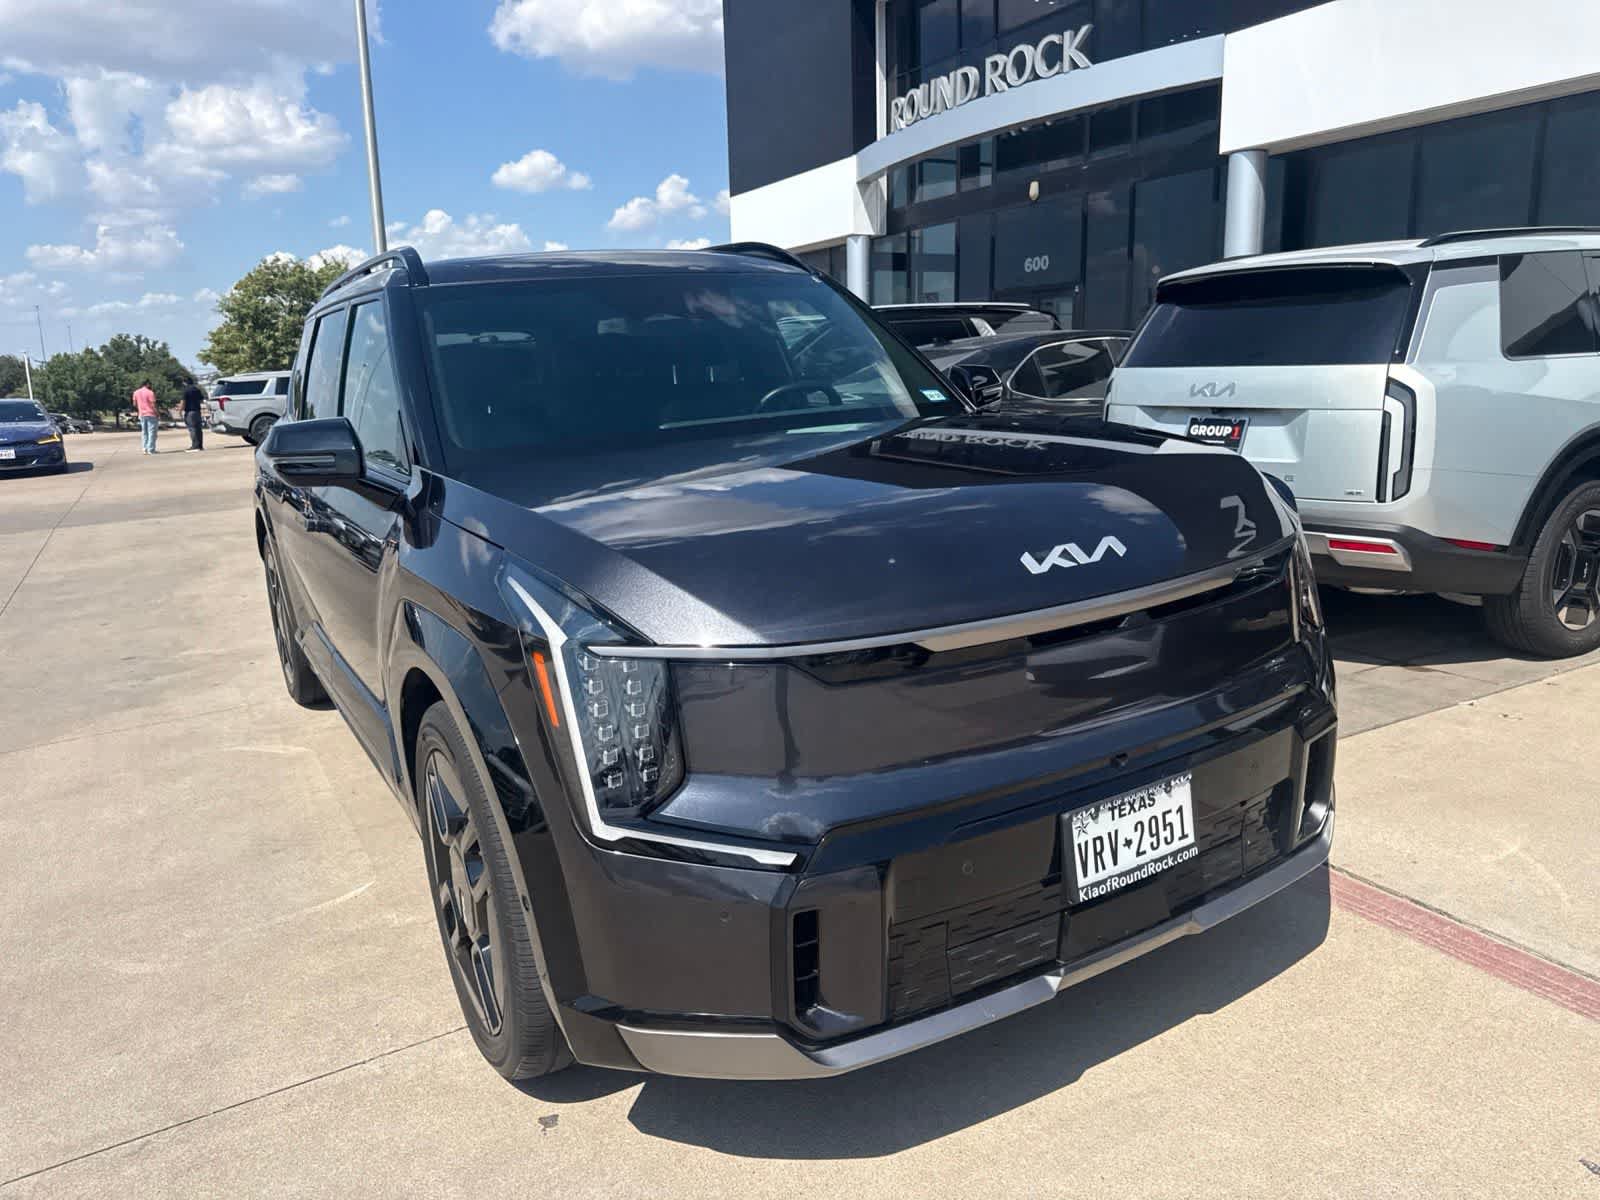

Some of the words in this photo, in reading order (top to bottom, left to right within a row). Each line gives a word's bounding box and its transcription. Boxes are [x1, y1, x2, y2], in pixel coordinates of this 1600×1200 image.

[890, 66, 980, 132] ROUND
[985, 23, 1094, 97] ROCK
[1024, 255, 1049, 272] 600
[1190, 381, 1237, 399] KIA
[1020, 535, 1127, 575] KIA
[1108, 792, 1156, 821] TEXAS
[1078, 846, 1199, 902] KiaofRoundRock.com
